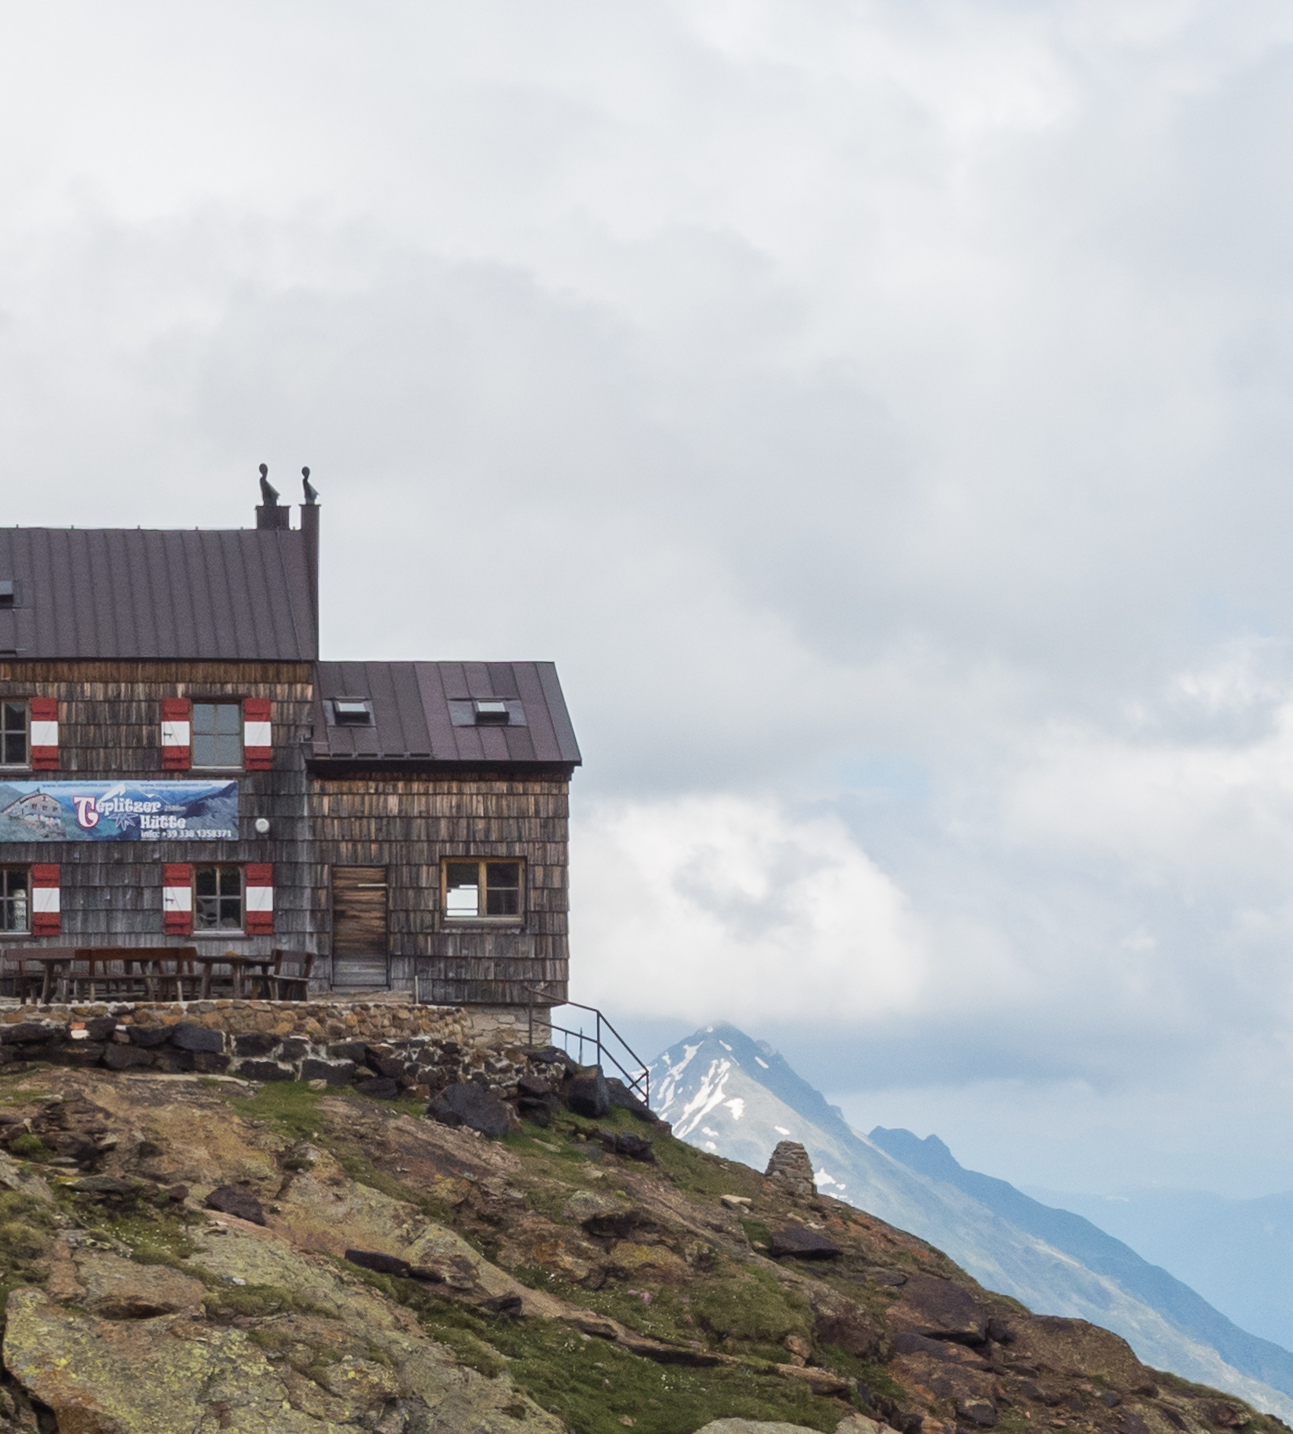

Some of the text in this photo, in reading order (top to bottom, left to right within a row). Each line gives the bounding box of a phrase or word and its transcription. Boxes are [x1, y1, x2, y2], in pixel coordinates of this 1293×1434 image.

[73, 795, 161, 828] Teplitzer
[140, 815, 186, 829] Hütte
[163, 829, 178, 838] +39
